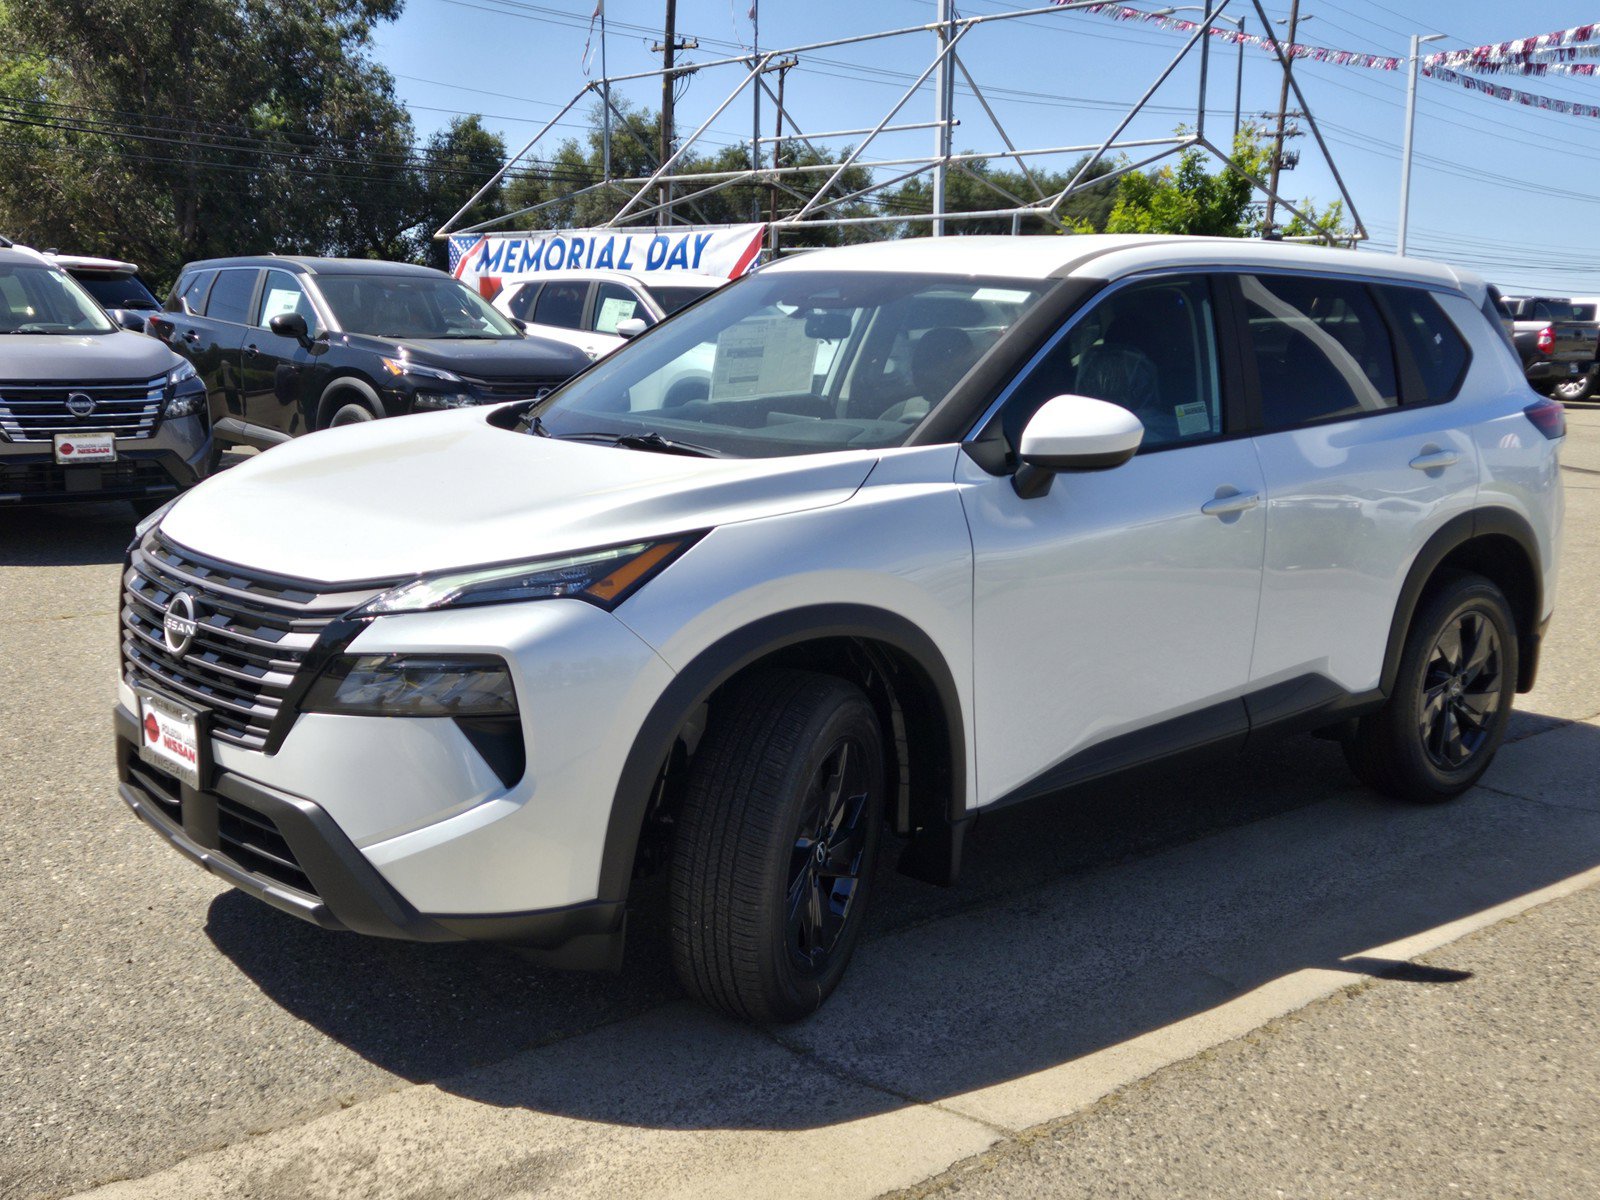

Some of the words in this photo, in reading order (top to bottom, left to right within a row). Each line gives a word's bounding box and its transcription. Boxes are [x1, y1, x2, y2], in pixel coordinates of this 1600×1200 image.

[475, 235, 634, 273] MEMORIAL
[645, 233, 714, 271] DAY
[163, 734, 196, 764] NISSAN
